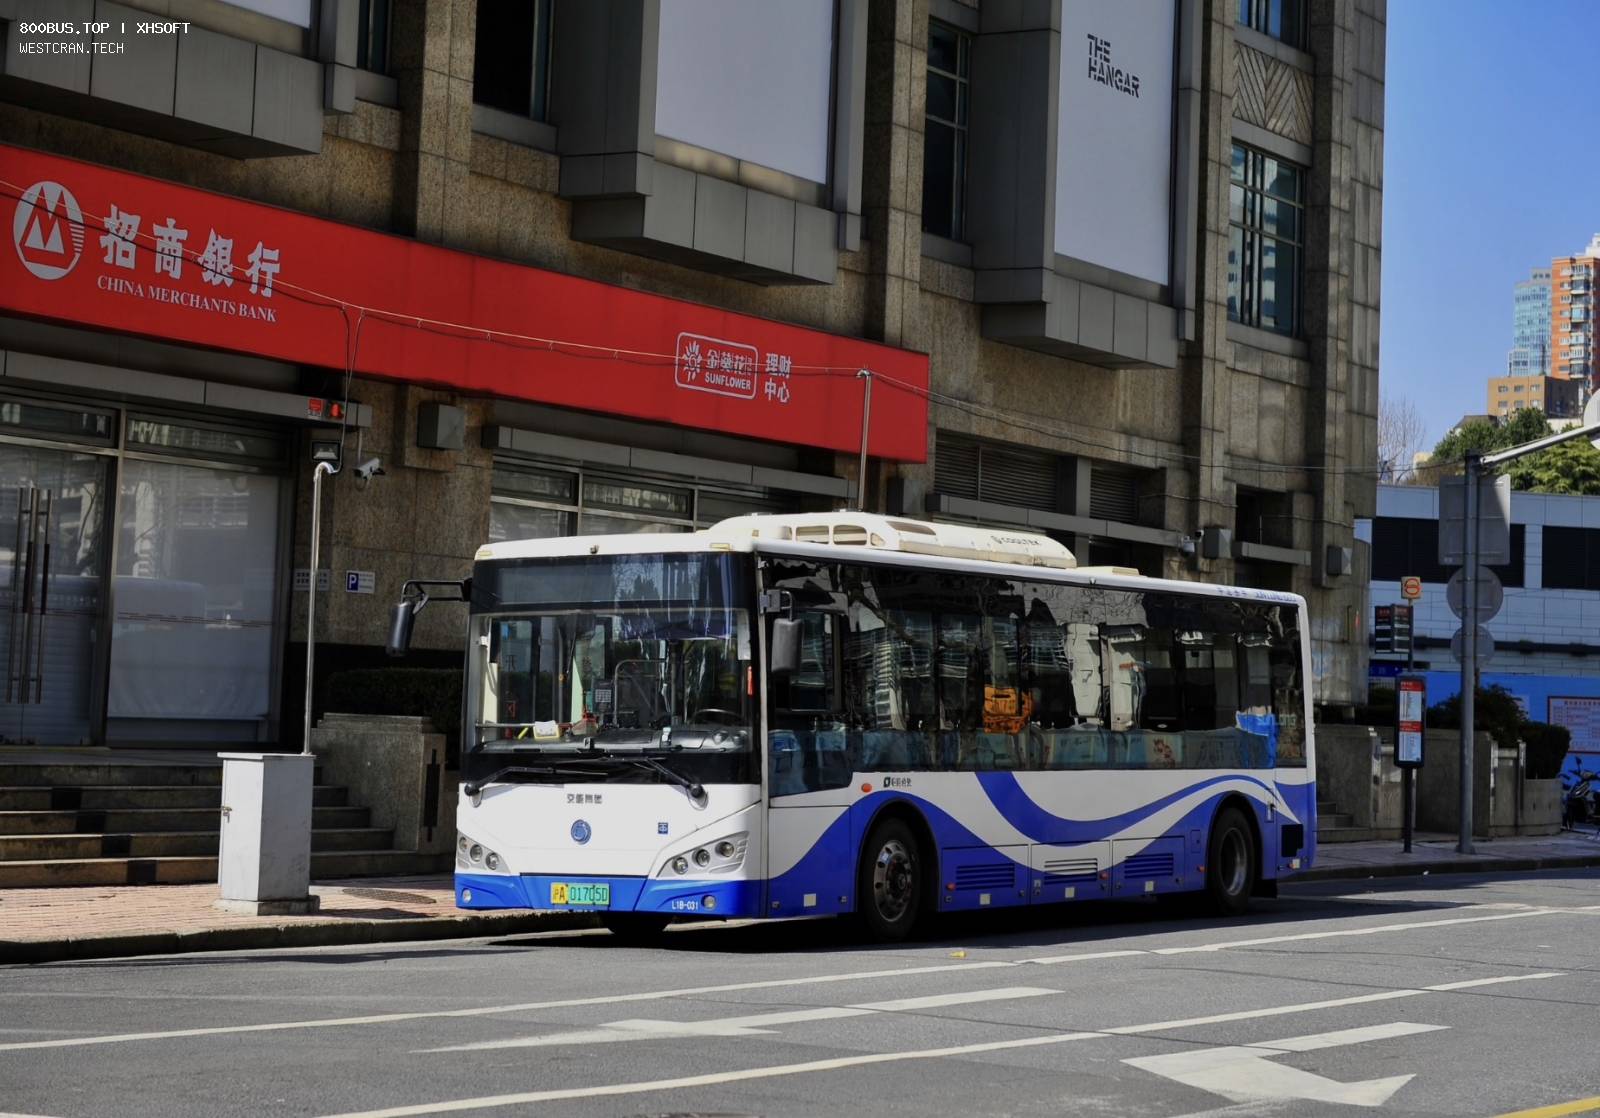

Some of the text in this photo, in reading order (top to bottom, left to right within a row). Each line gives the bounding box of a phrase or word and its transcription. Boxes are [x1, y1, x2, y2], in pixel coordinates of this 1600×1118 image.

[1087, 33, 1111, 64] THE
[1088, 57, 1140, 99] HANGAR
[97, 274, 277, 323] CHINA MERCHANTS BANK
[704, 371, 752, 391] SUNFLOWER
[764, 377, 791, 403] 中心
